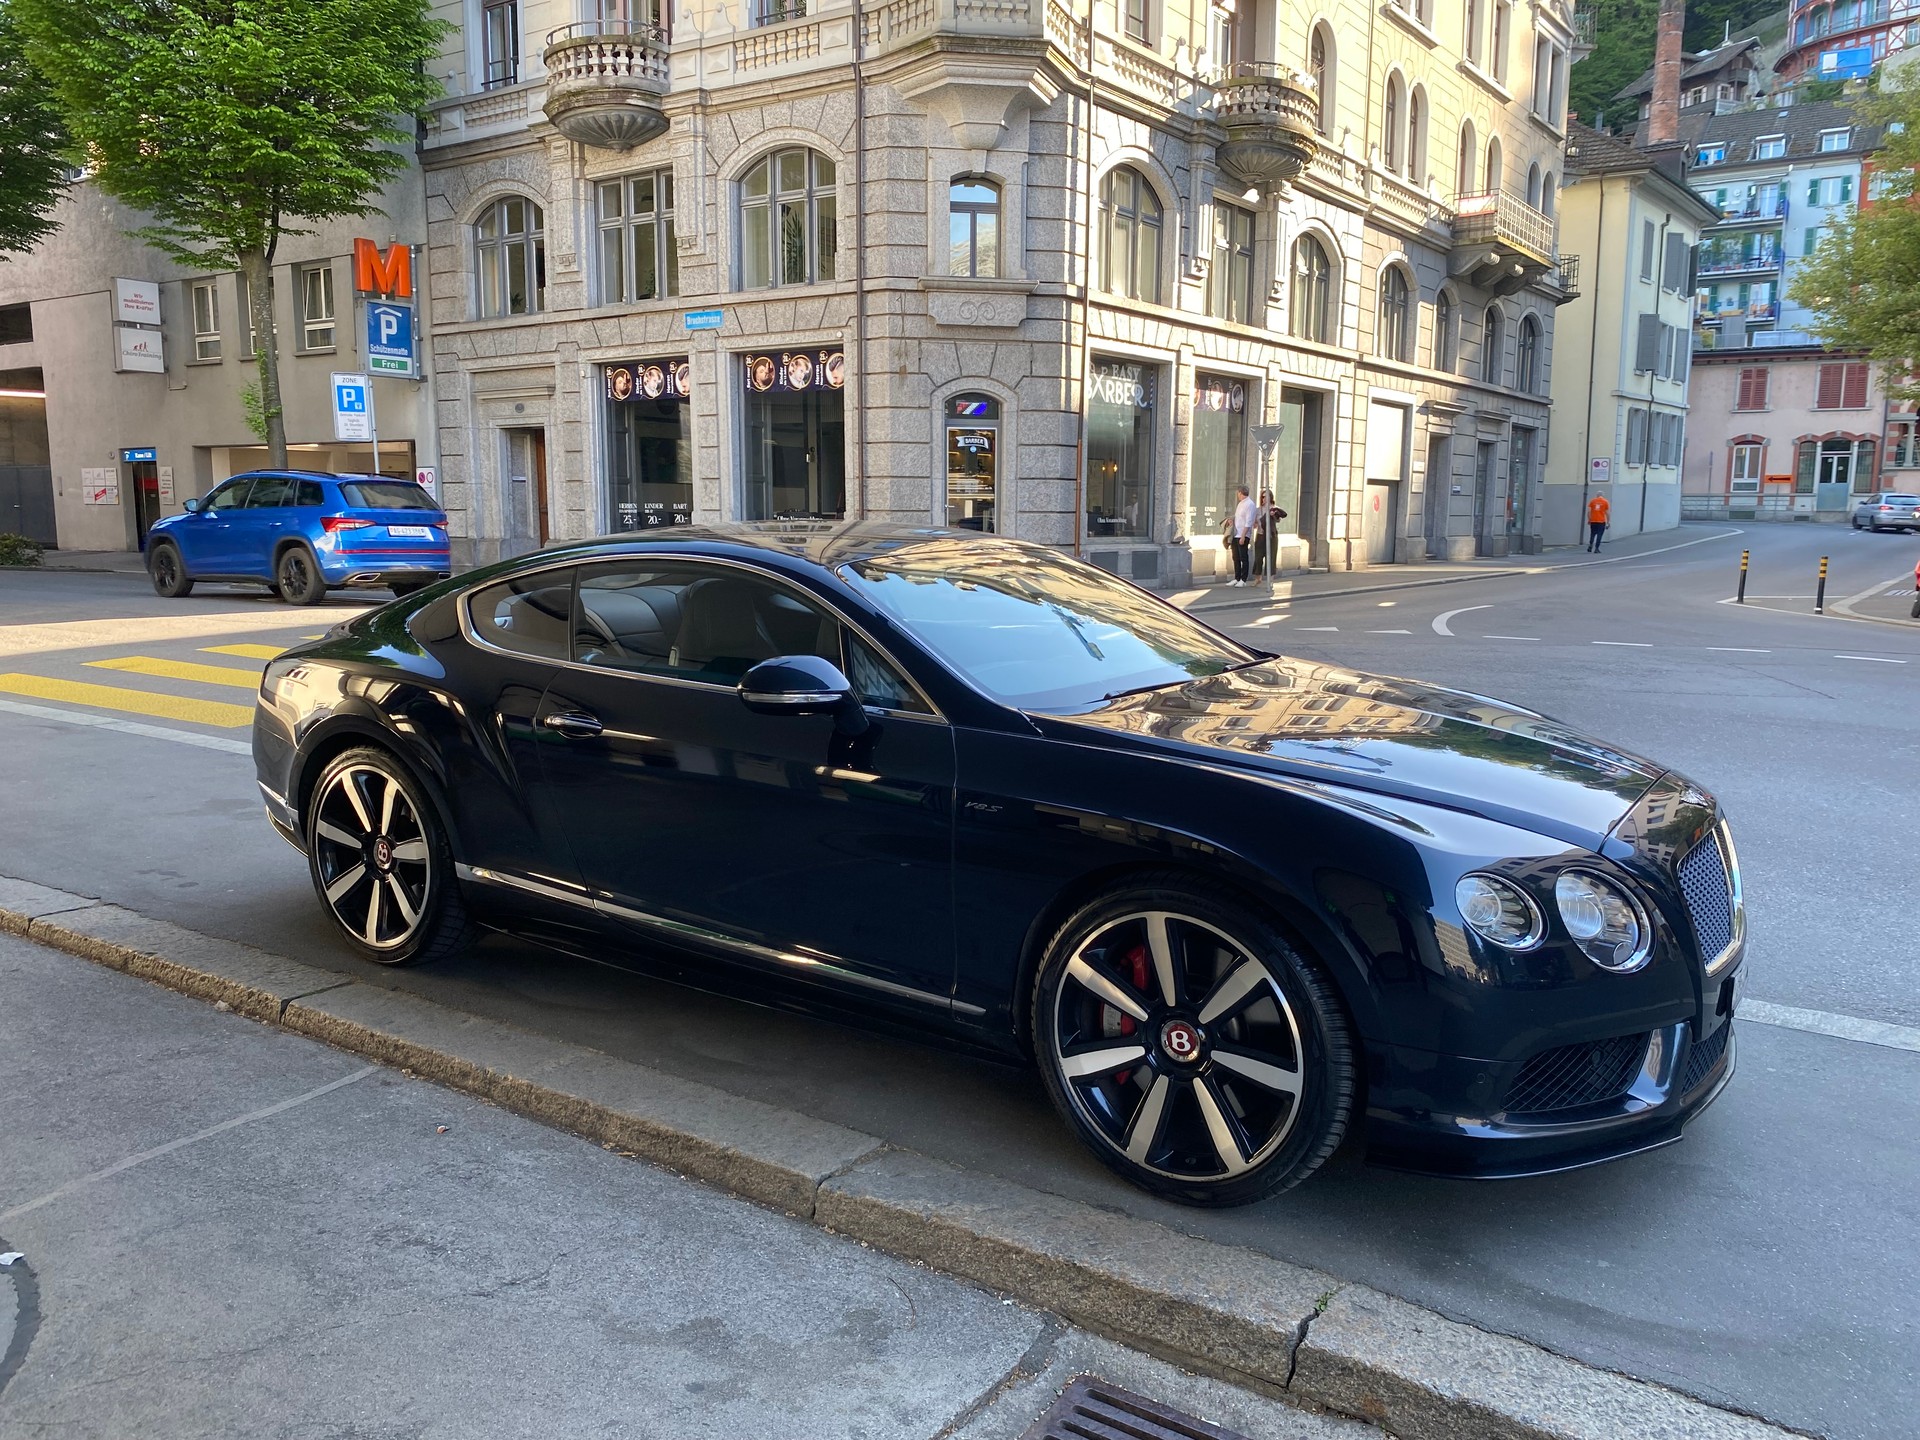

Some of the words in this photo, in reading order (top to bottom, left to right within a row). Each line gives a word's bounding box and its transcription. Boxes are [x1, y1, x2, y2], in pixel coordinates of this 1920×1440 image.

[354, 237, 412, 297] M
[380, 314, 398, 344] P
[370, 344, 408, 356] Schützenmatte
[381, 360, 399, 369] Frei
[1112, 364, 1140, 382] EASY
[342, 389, 356, 408] P
[647, 515, 662, 525] 20.-
[674, 513, 688, 523] 20.-
[1170, 1030, 1191, 1052] B
